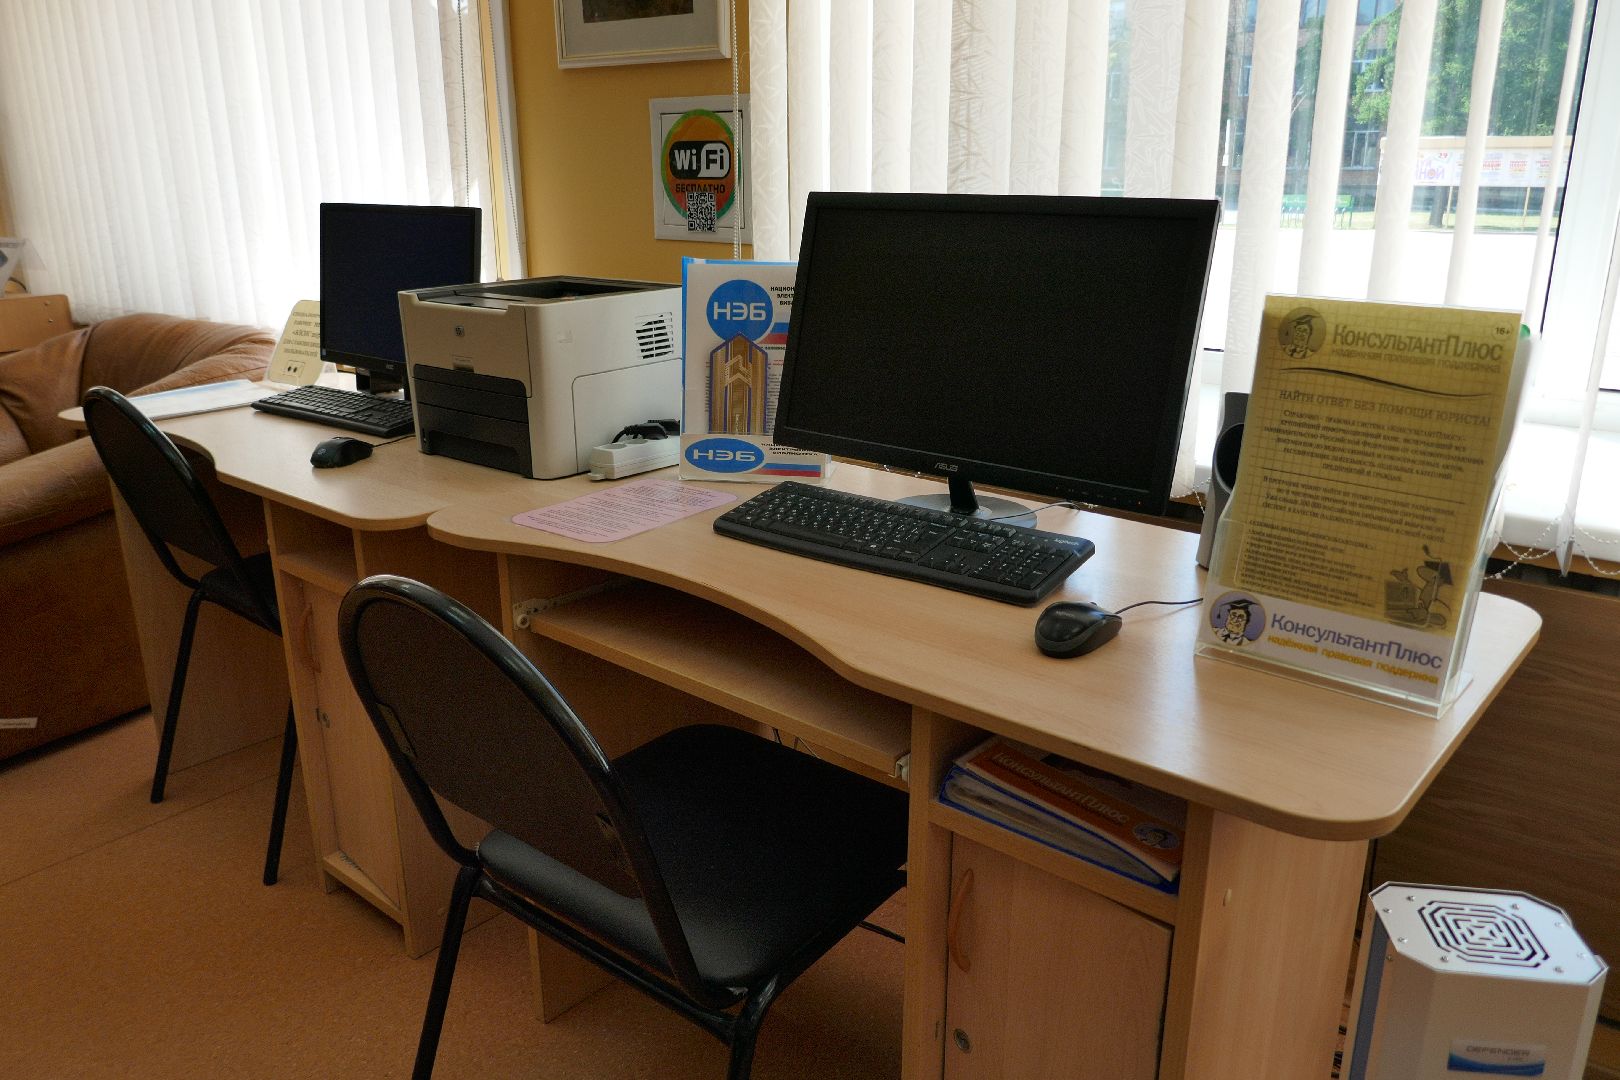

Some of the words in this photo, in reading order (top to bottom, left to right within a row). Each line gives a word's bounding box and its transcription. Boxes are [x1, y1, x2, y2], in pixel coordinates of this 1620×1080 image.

[675, 184, 726, 194] БЕСПЛАТНО
[713, 301, 767, 321] НЭБ
[1495, 327, 1510, 335] 16+
[1279, 390, 1314, 402] НАЙТИ
[1316, 395, 1352, 408] ОТВЕТ
[1353, 399, 1376, 412] БЕЗ
[1378, 402, 1433, 419] ПОМОЩИ
[1436, 410, 1491, 427] ЮРИСТА!
[693, 449, 756, 462] НЭБ
[934, 461, 959, 472] ASUS
[1271, 613, 1443, 669] КонсультантПлюс
[1321, 648, 1374, 668] правовая
